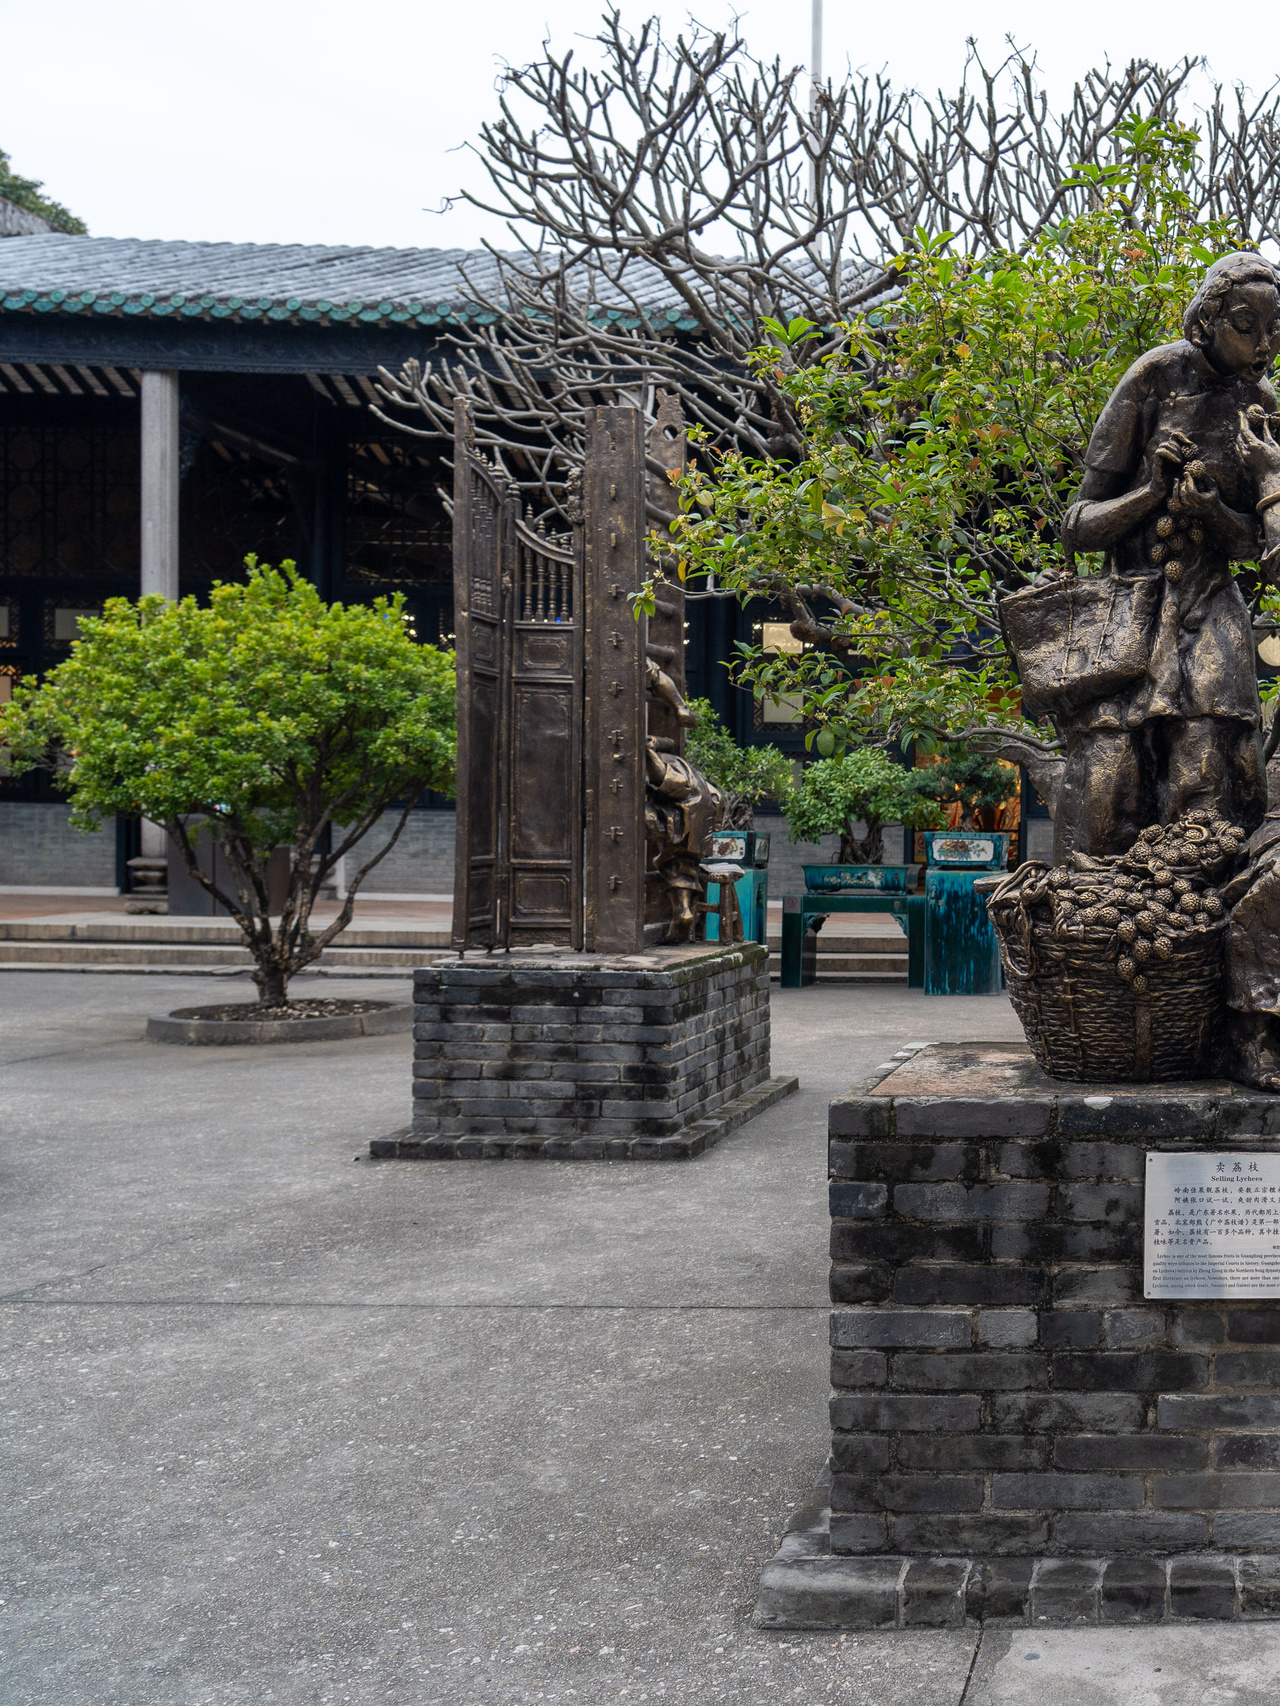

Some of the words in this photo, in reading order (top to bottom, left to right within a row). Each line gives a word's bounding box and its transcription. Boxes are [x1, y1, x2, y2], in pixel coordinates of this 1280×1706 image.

[1216, 1161, 1259, 1173] 卖荔枝
[1211, 1175, 1235, 1183] Selling
[1236, 1175, 1263, 1183] Lychees
